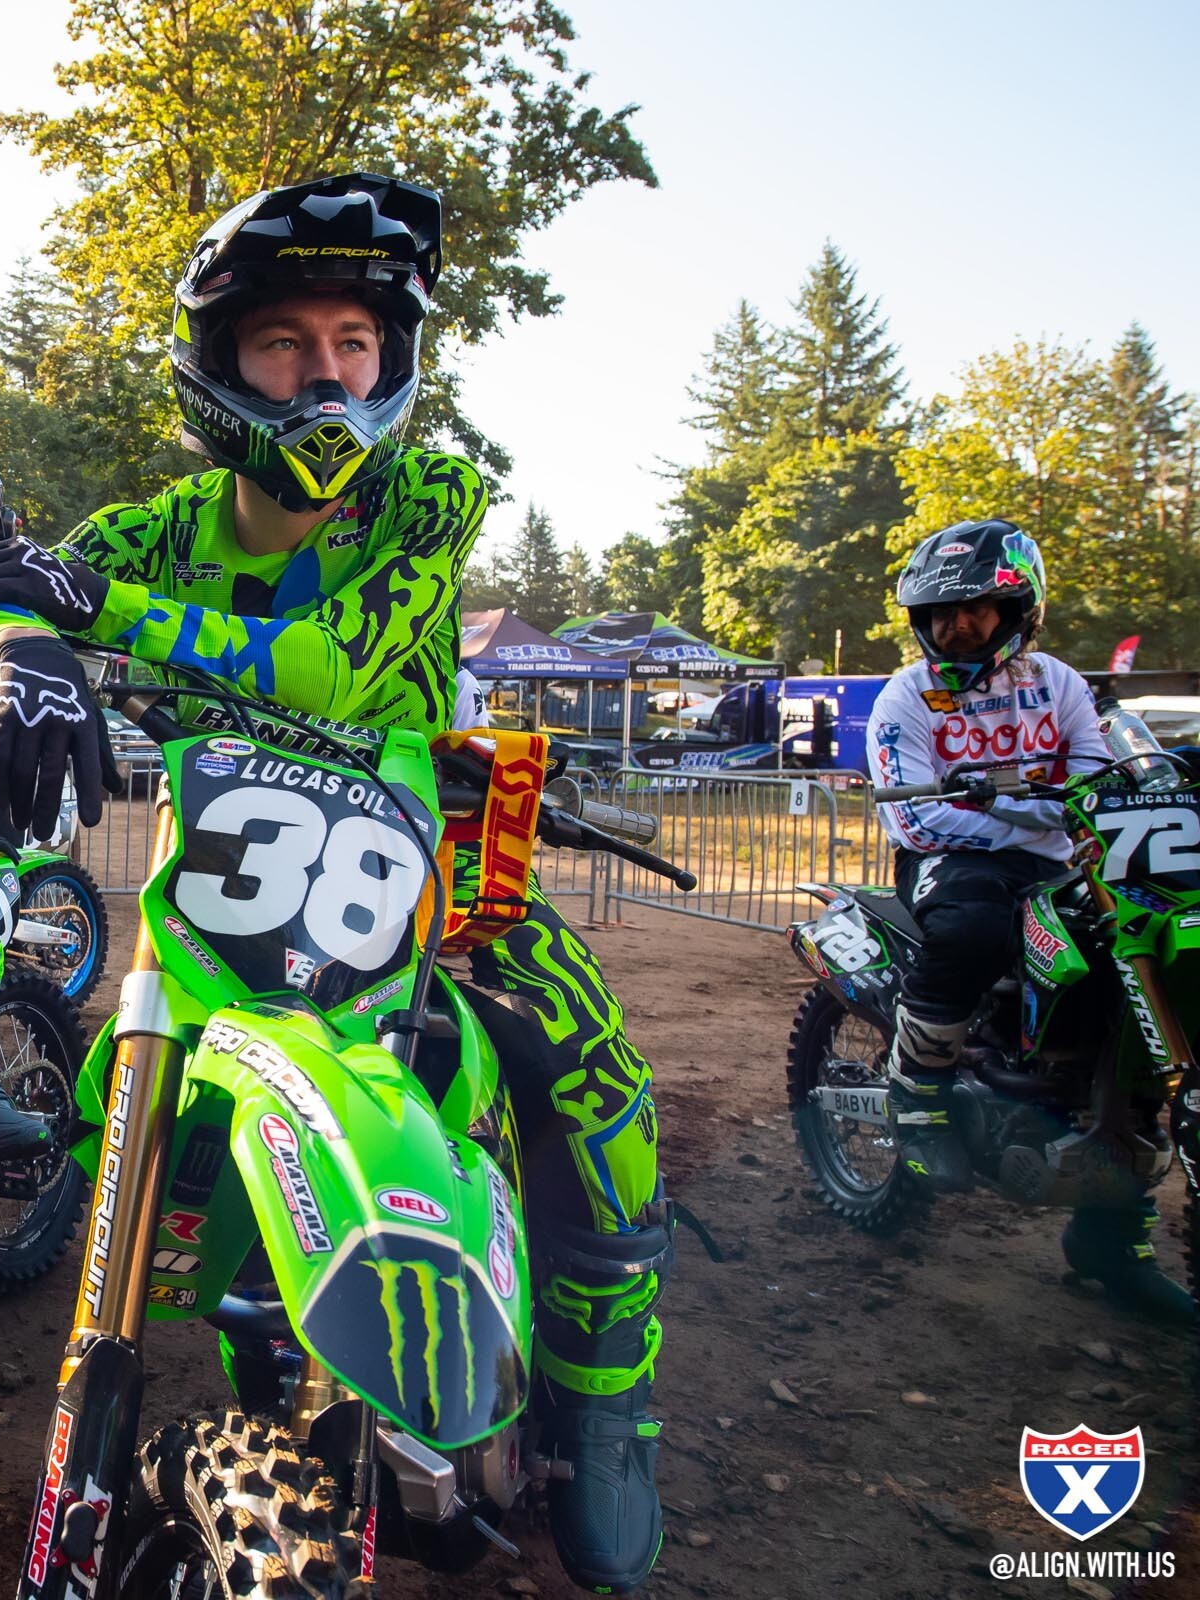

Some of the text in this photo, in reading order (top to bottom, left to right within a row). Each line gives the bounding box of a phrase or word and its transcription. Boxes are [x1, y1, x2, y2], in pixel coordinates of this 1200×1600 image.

[276, 247, 391, 260] PRO CIRCUIT
[177, 381, 241, 436] MONSTER
[322, 404, 343, 412] BELL
[507, 662, 534, 672] TRACK
[535, 663, 553, 672] SIDE
[554, 663, 592, 673] SUPPORT
[932, 711, 1059, 762] Coors
[240, 758, 343, 795] LUCAS
[347, 783, 387, 817] OIL
[794, 791, 804, 807] 8
[1126, 794, 1198, 806] LUCAS OIL
[1095, 807, 1200, 882] 72
[175, 785, 426, 972] 38
[813, 913, 881, 973] 726
[200, 1021, 249, 1056] PRO
[84, 1063, 135, 1320] PRO CIRCUIT
[279, 1144, 334, 1253] MAXIMA
[388, 1193, 442, 1219] BELL
[176, 1289, 197, 1307] 30
[28, 1406, 74, 1588] BRAKING
